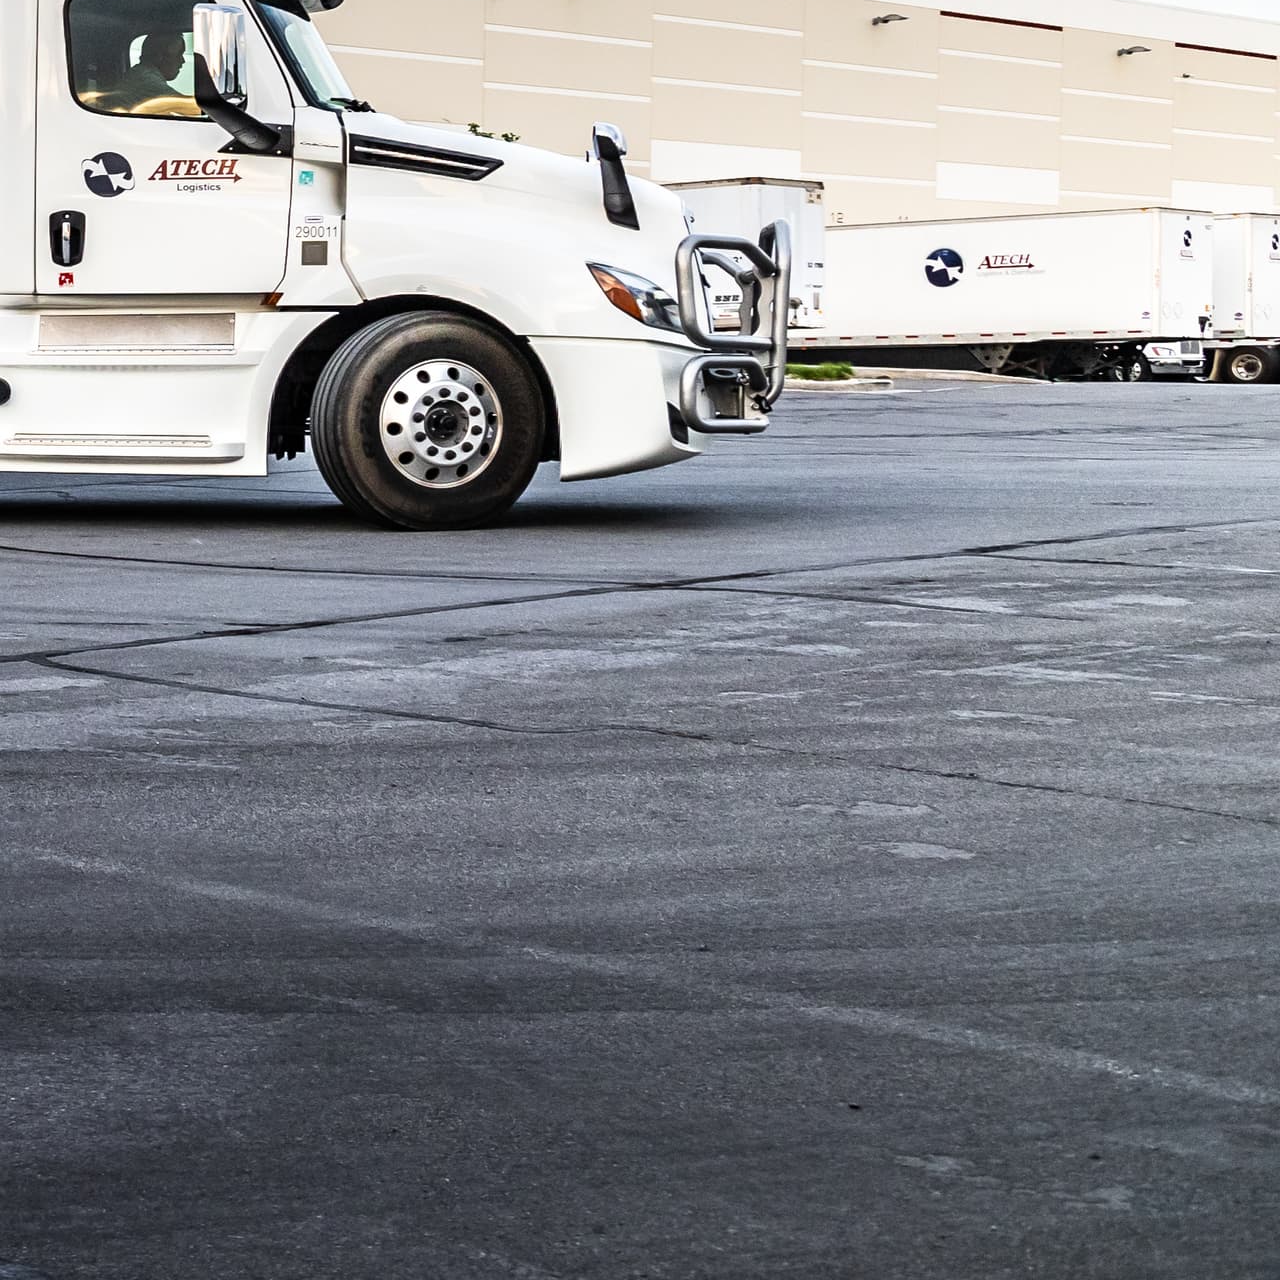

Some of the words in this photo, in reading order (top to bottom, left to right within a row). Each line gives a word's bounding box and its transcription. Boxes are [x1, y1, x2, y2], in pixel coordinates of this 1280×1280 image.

[148, 159, 239, 181] ATECH
[176, 183, 222, 193] Logistics
[295, 225, 337, 238] 290011
[977, 253, 1031, 269] ATECH
